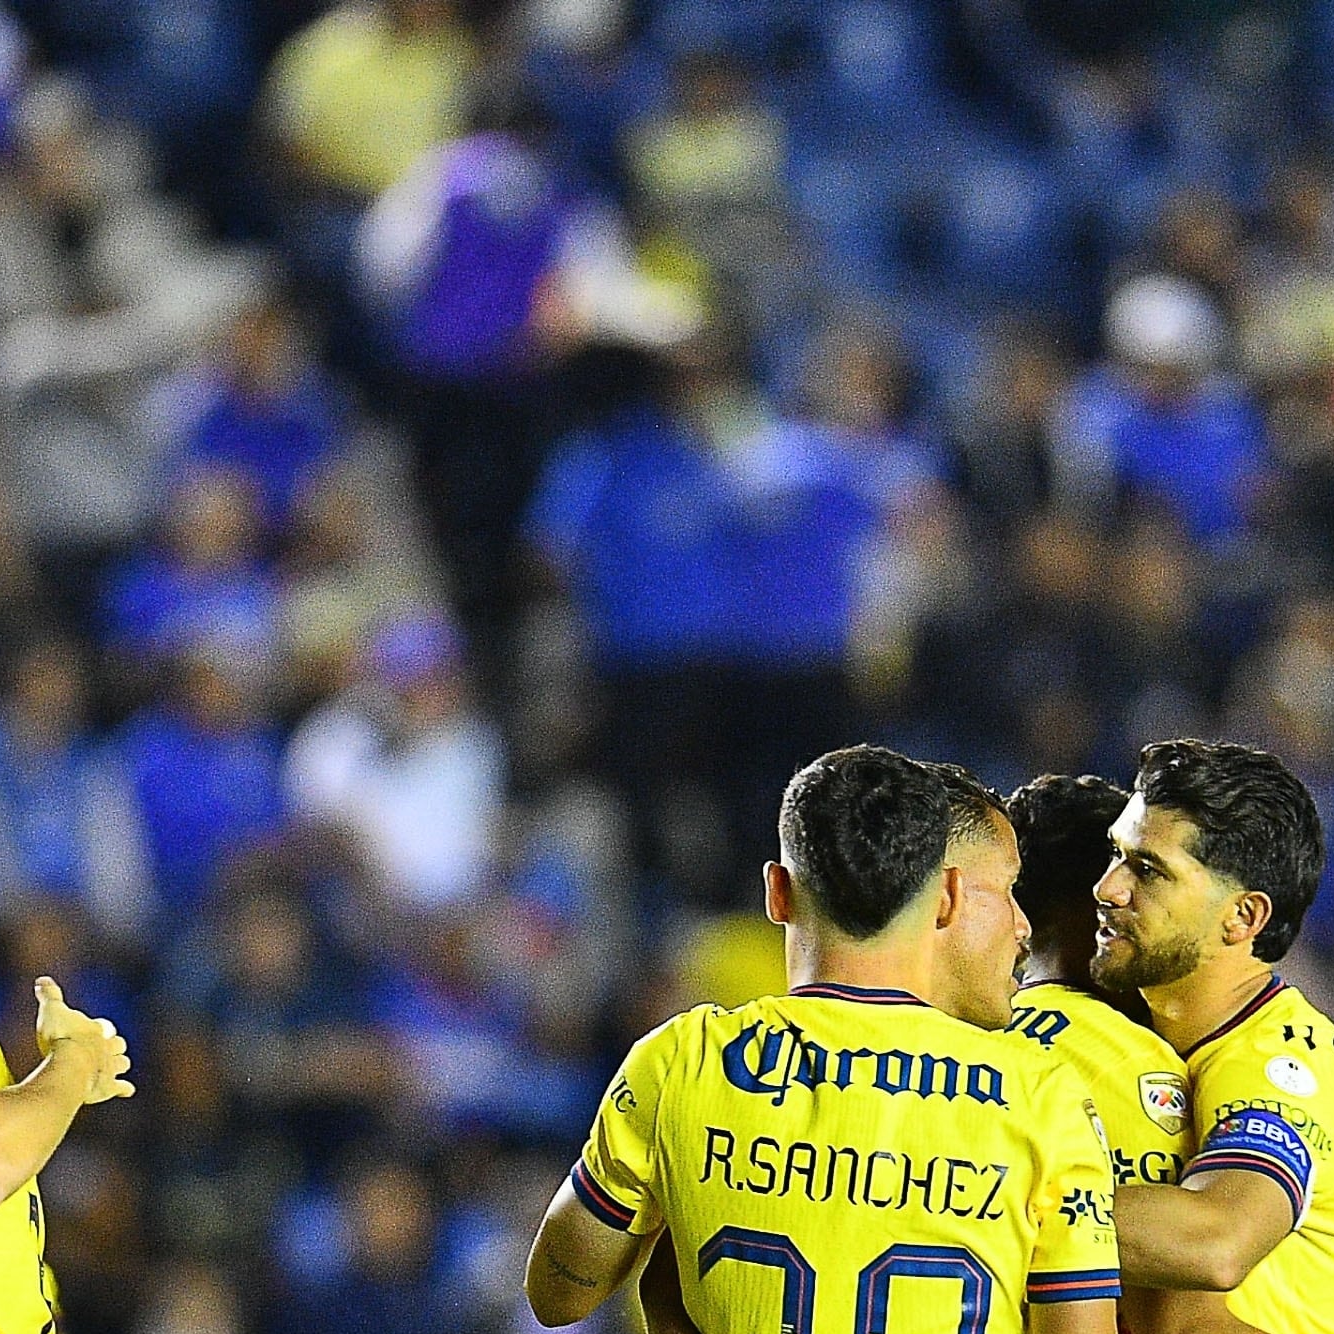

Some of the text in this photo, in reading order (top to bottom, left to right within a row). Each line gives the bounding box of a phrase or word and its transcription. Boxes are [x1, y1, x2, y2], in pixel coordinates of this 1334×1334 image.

[721, 1020, 1009, 1110] Corona
[699, 1124, 1009, 1220] R.SANCHEZ
[1245, 1117, 1308, 1167] BBVA
